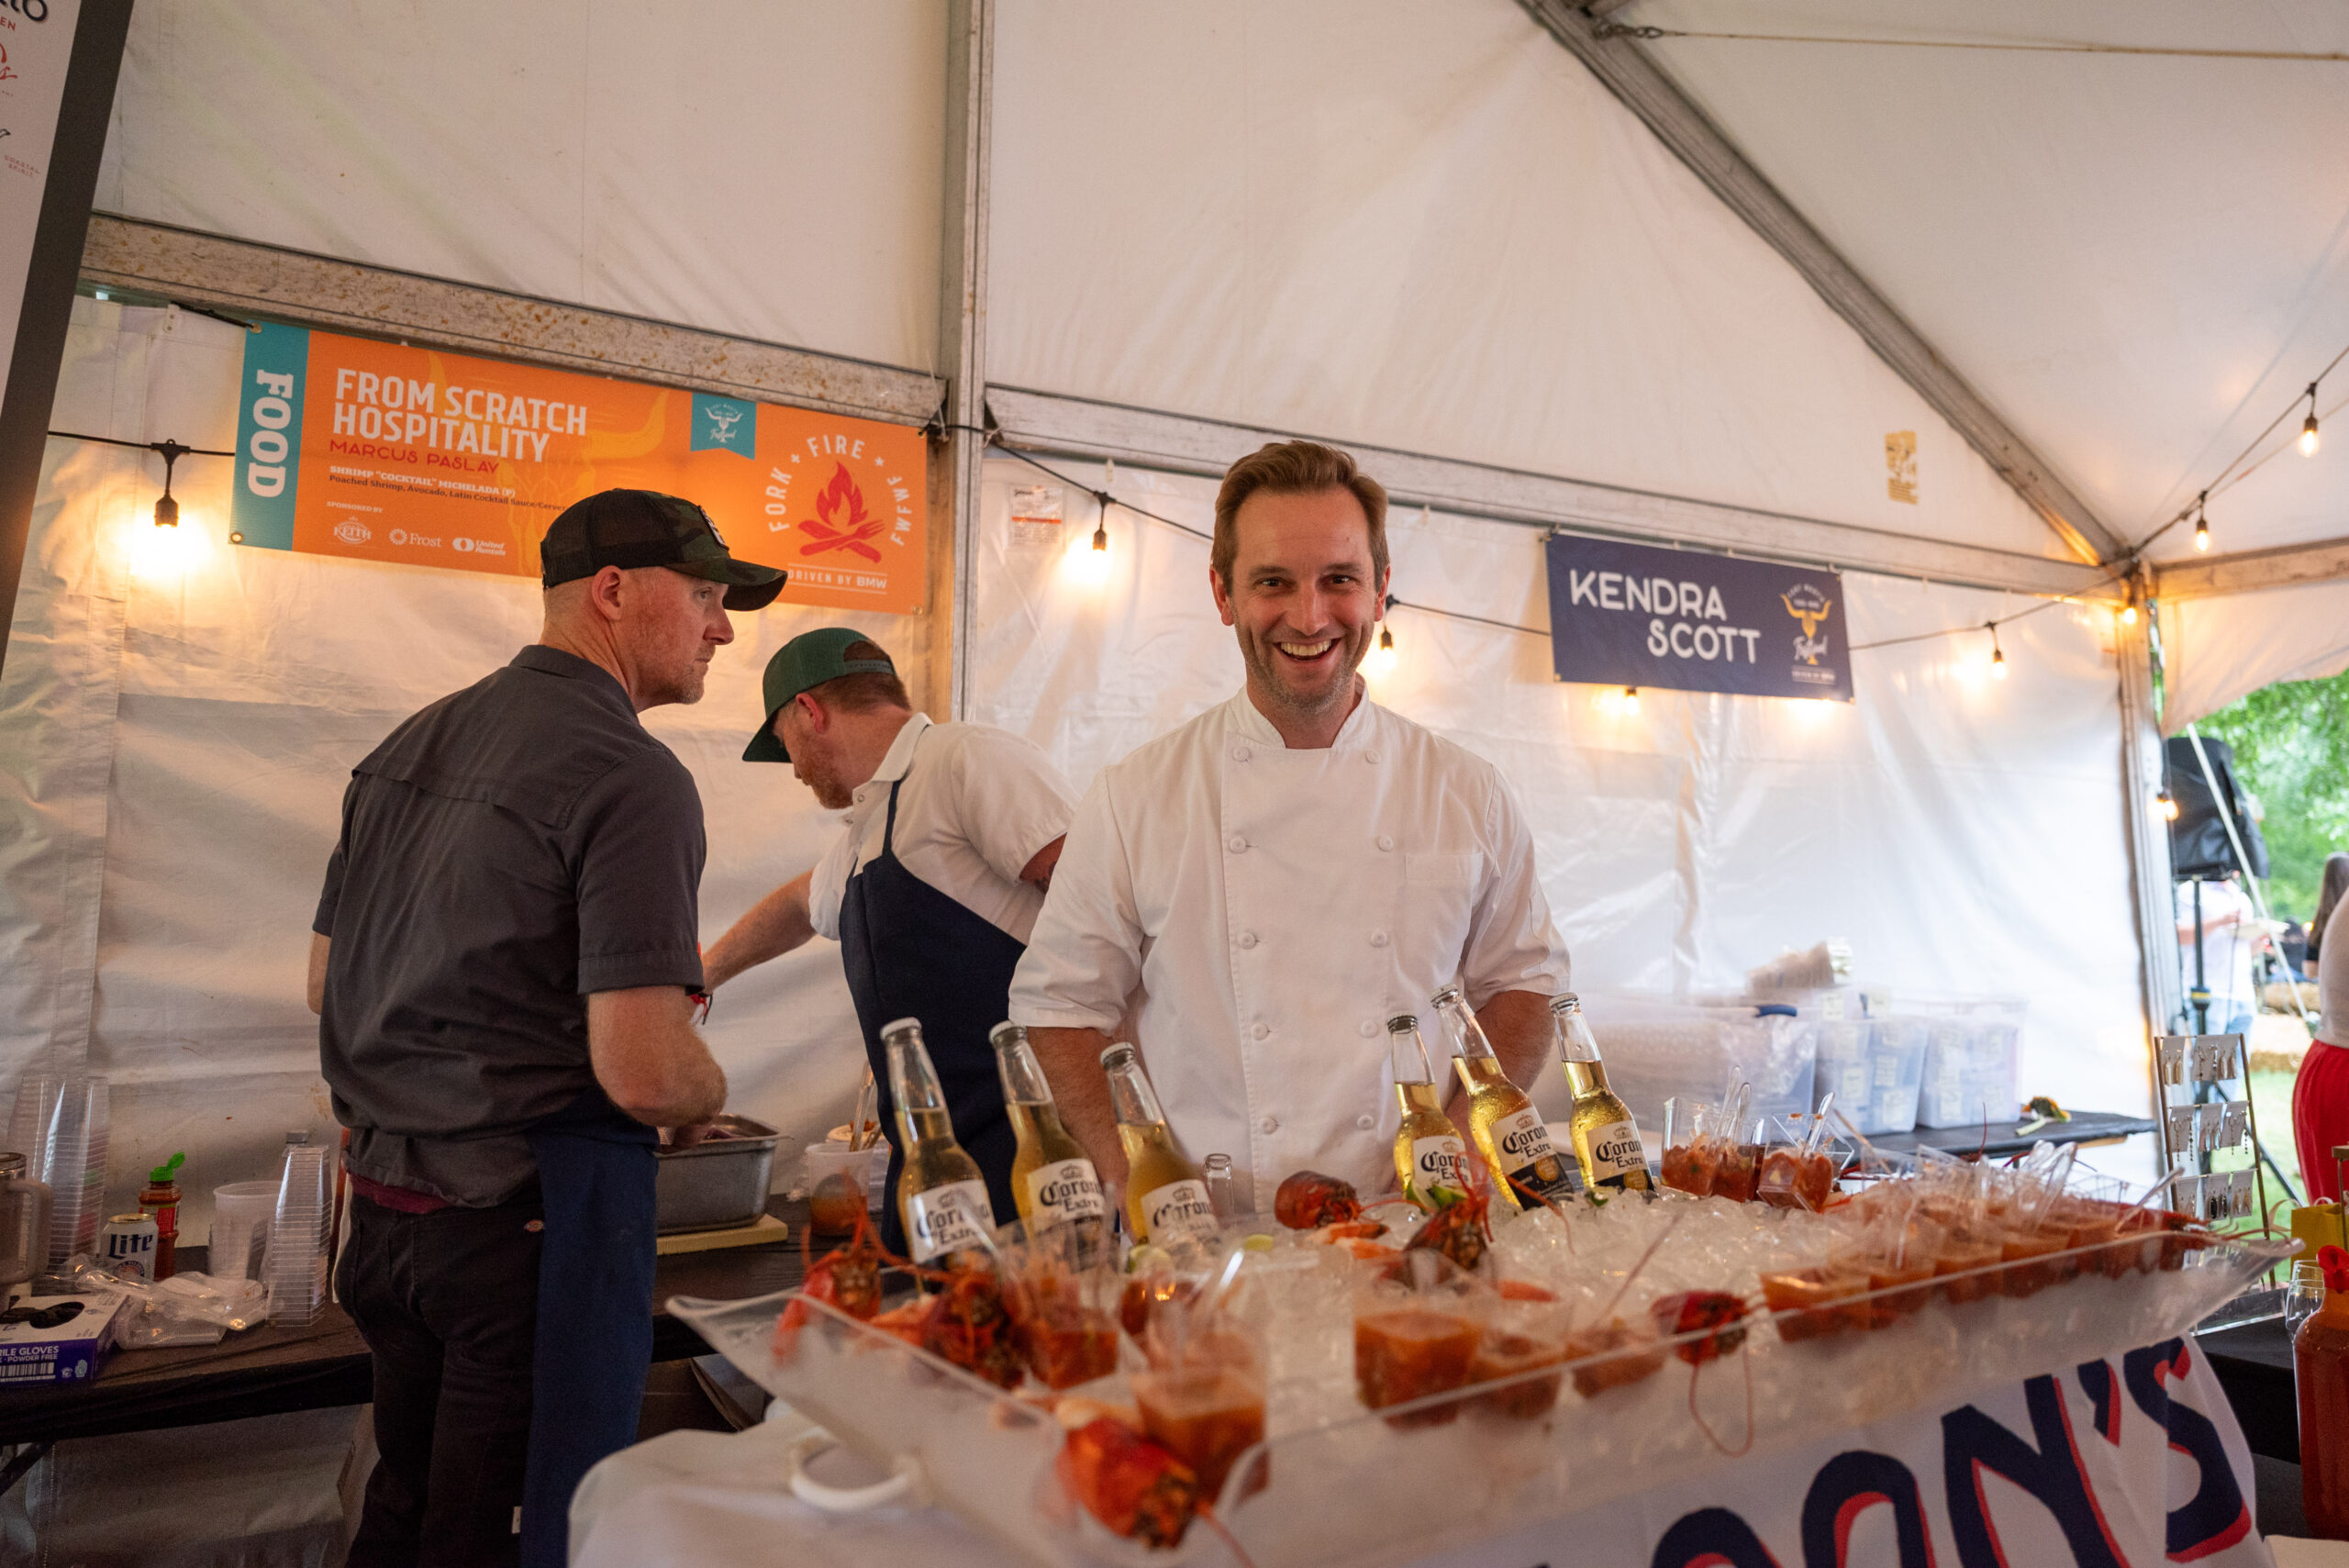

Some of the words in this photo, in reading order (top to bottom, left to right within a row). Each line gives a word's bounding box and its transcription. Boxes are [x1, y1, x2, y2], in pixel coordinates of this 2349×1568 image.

[336, 368, 436, 414] FROM
[444, 385, 587, 436] SCRATCH
[247, 369, 294, 497] FOOD
[333, 402, 550, 462] HOSPITALITY
[329, 439, 418, 463] MARCUS
[427, 453, 500, 474] PASLAY
[329, 465, 374, 478] SHRIMP
[375, 470, 438, 486] "COCKTAIL"
[438, 480, 500, 495] MICHELADA
[501, 487, 517, 498] (P)
[329, 474, 368, 486] Poached
[370, 480, 406, 492] Shrimp,
[406, 484, 448, 497] Avocado,
[449, 490, 472, 500] Latin
[473, 494, 508, 505] Cocktail
[764, 467, 793, 533] FORK
[807, 434, 865, 460] FIRE
[326, 501, 373, 512] SPONSORED
[333, 526, 372, 540] KEITH
[409, 532, 442, 547] Frost
[476, 539, 505, 550] United
[788, 568, 832, 584] DRIVEN
[837, 573, 852, 585] BY
[856, 576, 887, 589] BMW
[1569, 568, 1727, 621] KENDRA
[1646, 618, 1761, 664] SCOTT
[1501, 1126, 1549, 1154] Coron
[1595, 1140, 1643, 1162] Coron
[107, 1234, 153, 1260] Lite
[19, 1345, 60, 1356] GLOVES
